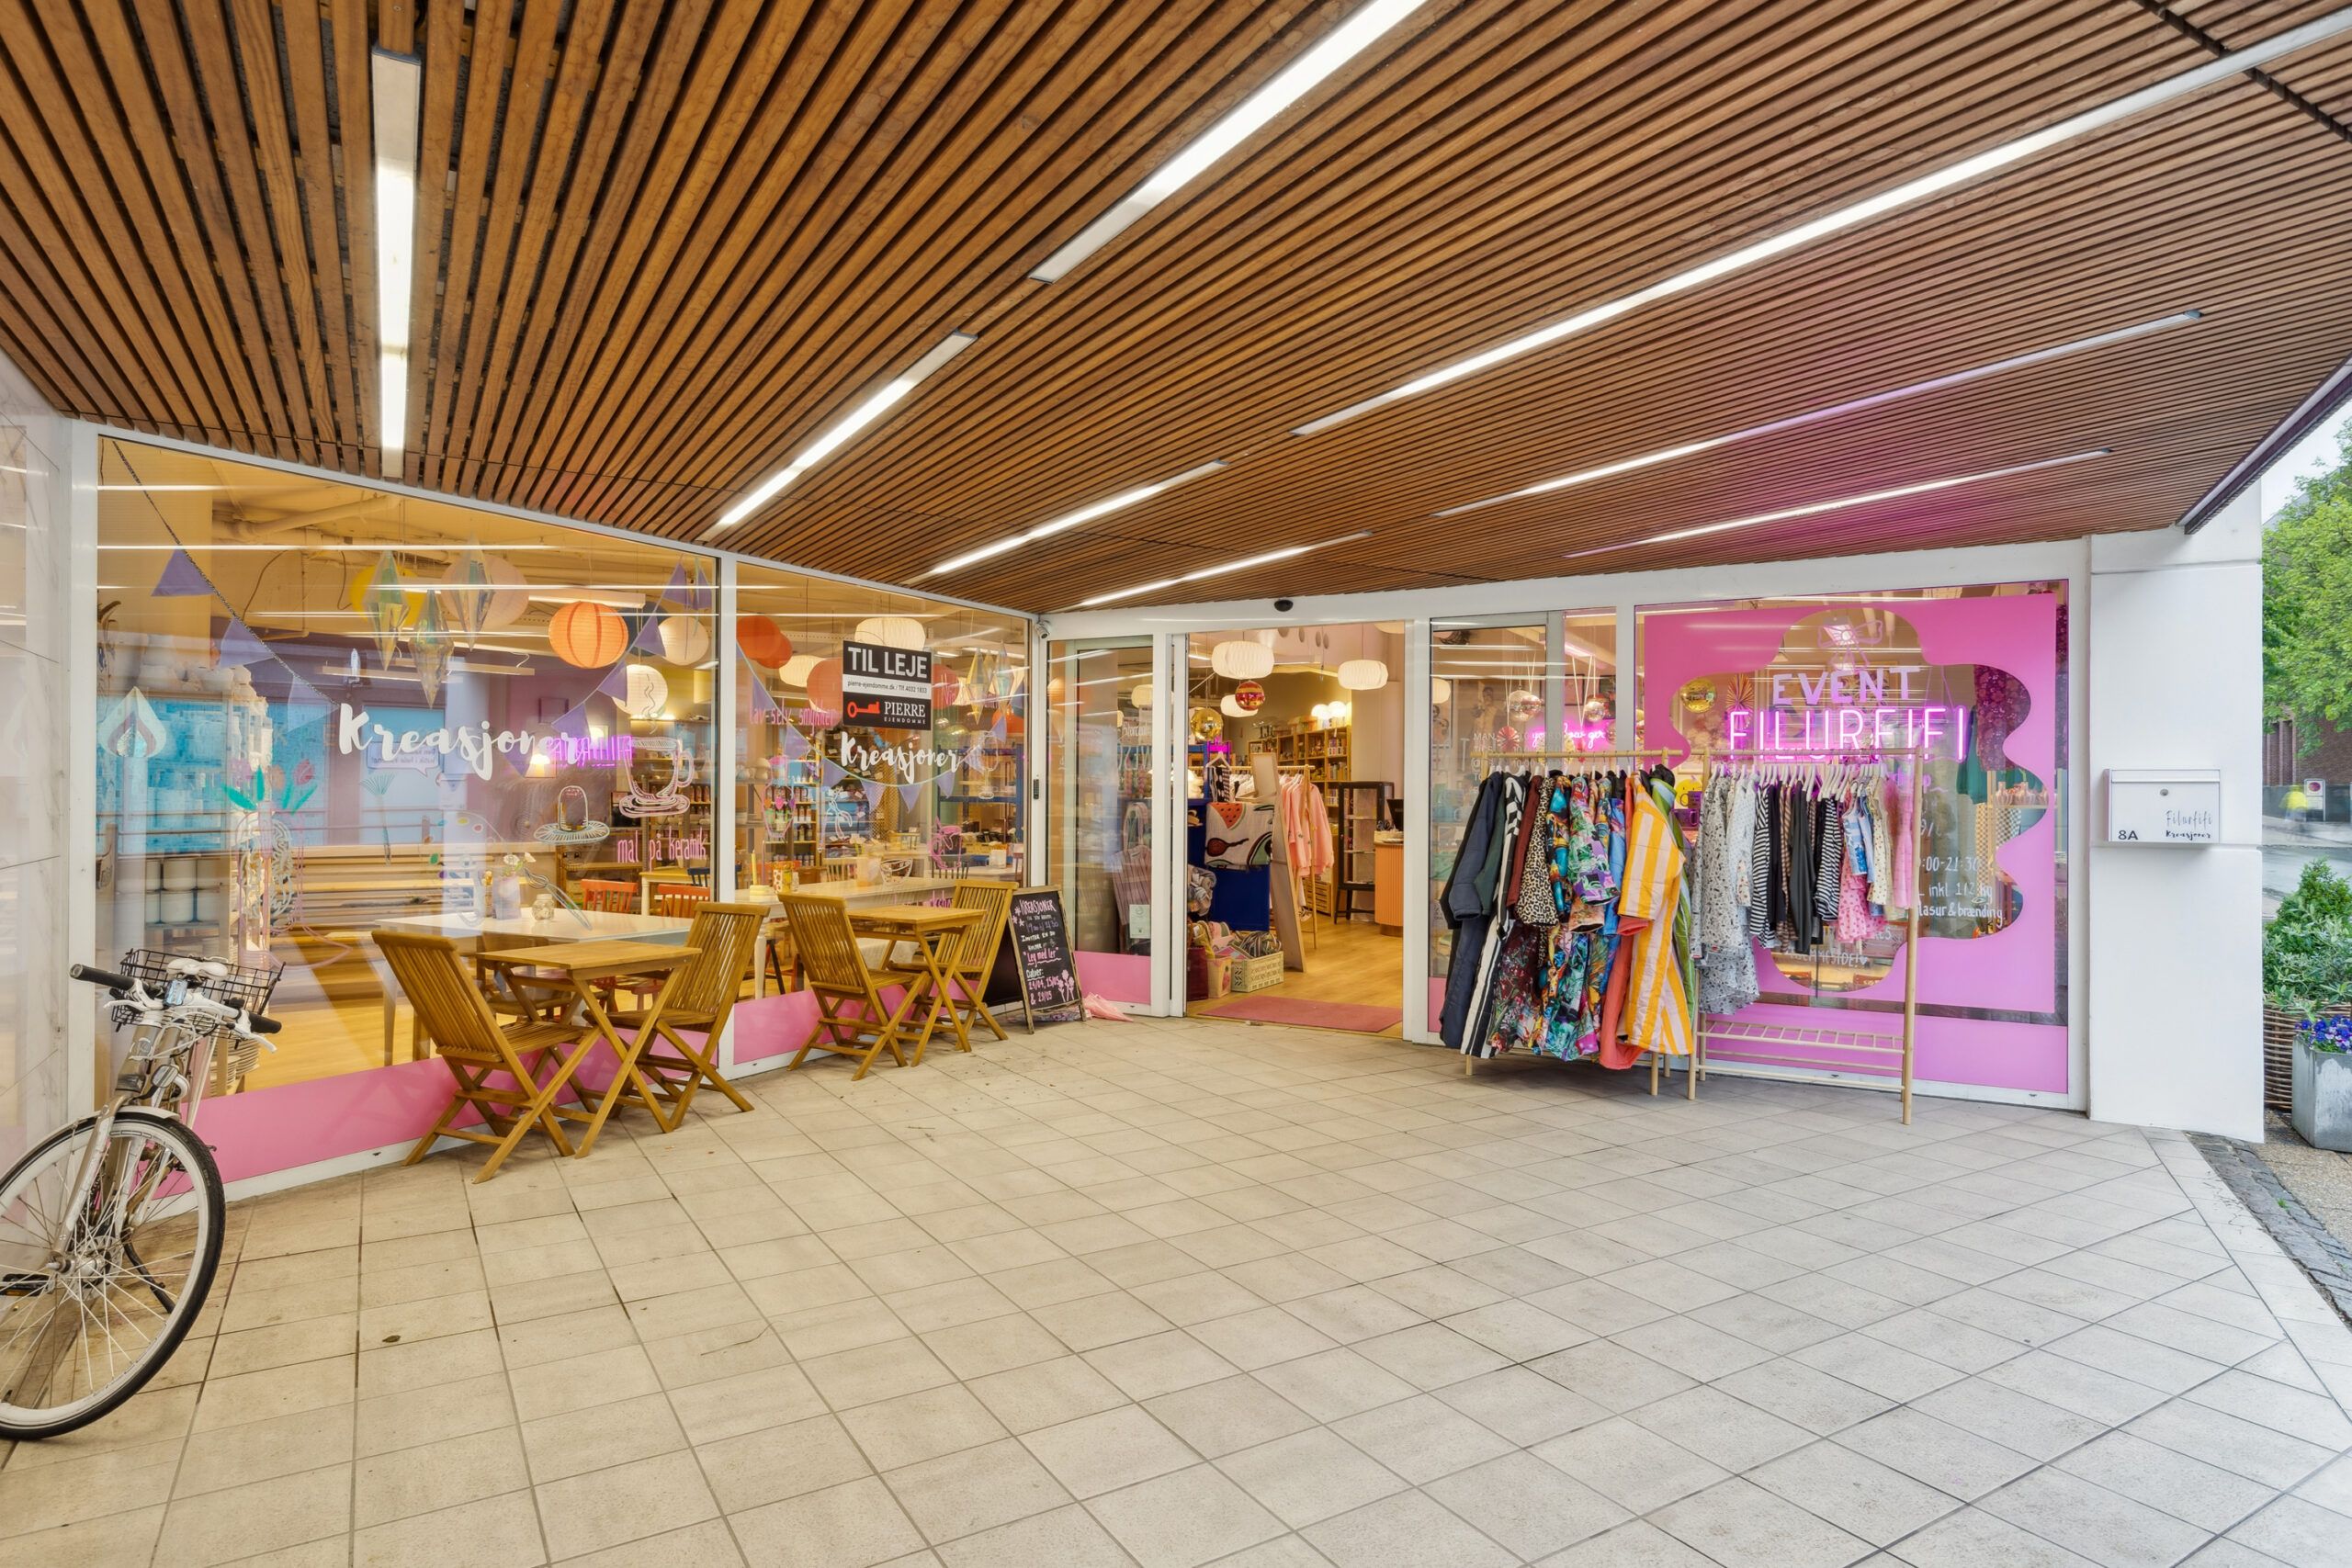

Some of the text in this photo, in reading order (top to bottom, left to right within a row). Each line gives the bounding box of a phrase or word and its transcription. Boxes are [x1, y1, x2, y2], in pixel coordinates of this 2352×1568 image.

[847, 647, 928, 679] TIL LEJE
[1772, 667, 1922, 705] EVENT
[884, 701, 926, 717] PIERRE
[884, 716, 926, 725] EJENDOMME
[338, 703, 579, 781] Kreasjoner
[1730, 707, 1965, 761] FILURFIFI
[841, 731, 965, 784] Kreasjoner
[617, 830, 639, 863] mal
[2118, 829, 2139, 840] 8A
[1918, 902, 1947, 917] lasur
